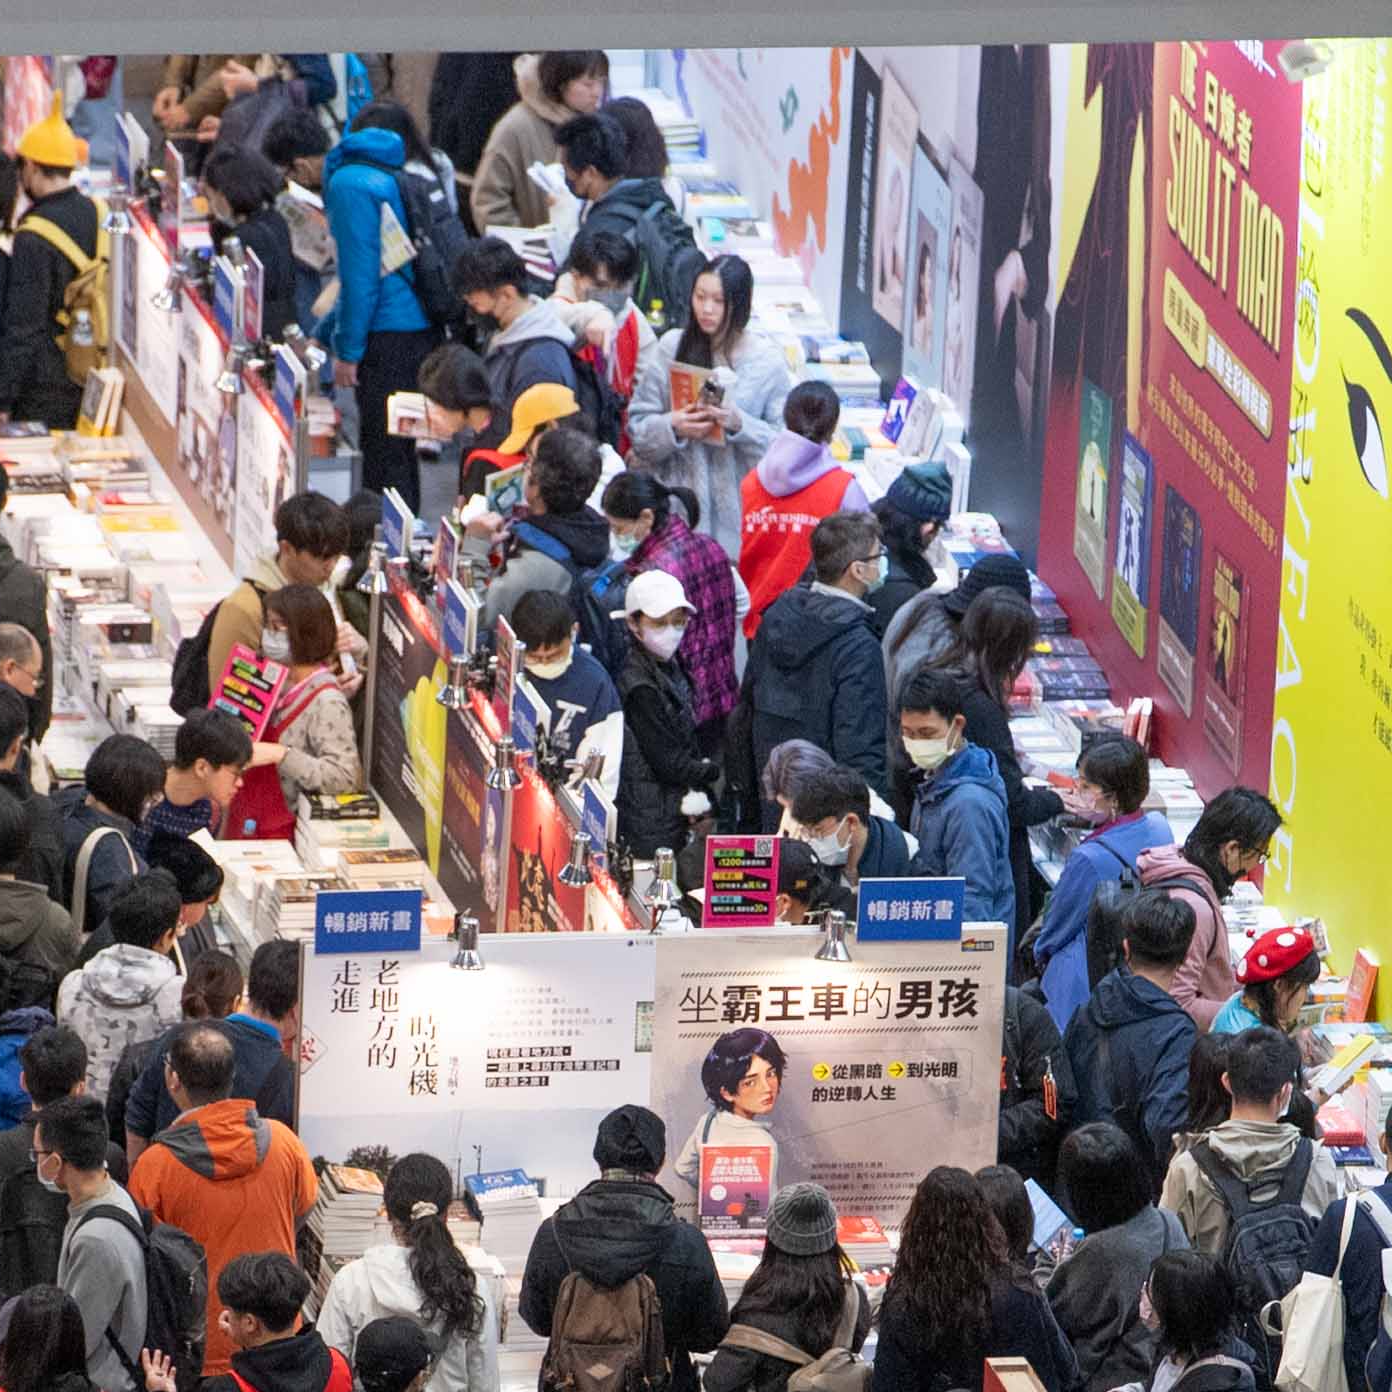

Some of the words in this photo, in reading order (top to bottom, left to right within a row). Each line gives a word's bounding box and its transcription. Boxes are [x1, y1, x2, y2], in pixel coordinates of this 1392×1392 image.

[1166, 94, 1237, 297] SUNLIT
[1237, 179, 1285, 358] MAN
[324, 910, 413, 934] 暢銷新書
[866, 898, 956, 924] 暢銷新書
[330, 959, 362, 1014] 走進
[679, 978, 982, 1026] 坐霸王車的男孩
[367, 959, 401, 1070] 老地方的
[408, 1012, 441, 1097] 時光機
[831, 1062, 883, 1080] 從黑暗
[907, 1060, 958, 1079] 到光明
[811, 1084, 897, 1102] 的逆轉人生
